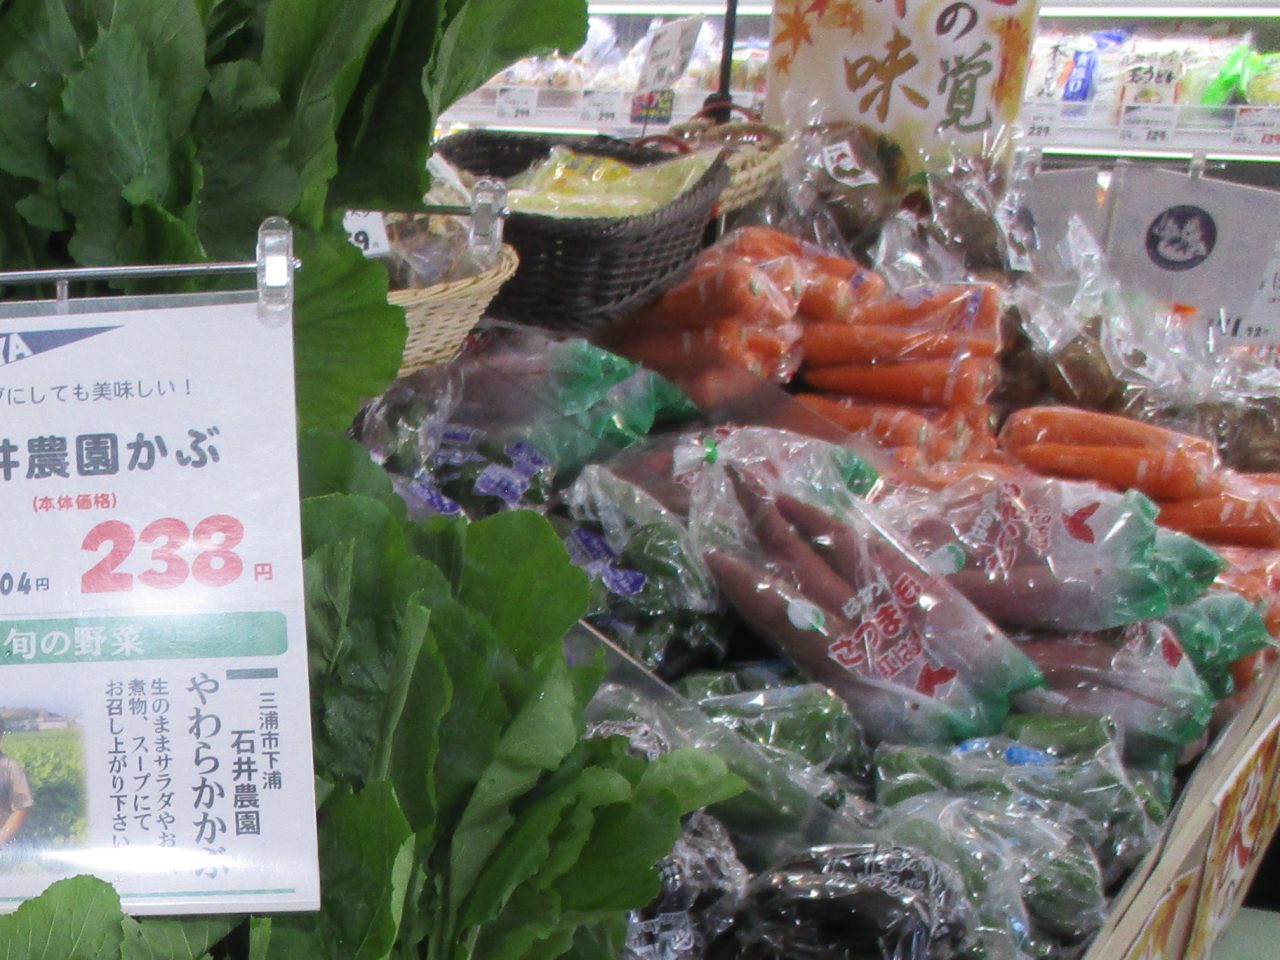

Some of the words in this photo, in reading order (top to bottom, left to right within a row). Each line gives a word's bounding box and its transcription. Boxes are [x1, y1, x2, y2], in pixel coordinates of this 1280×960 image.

[32, 492, 118, 513] (本体価格)
[3, 625, 145, 661] 旬の野菜
[258, 691, 283, 791] 三浦市下浦
[230, 729, 261, 836] 石井農園
